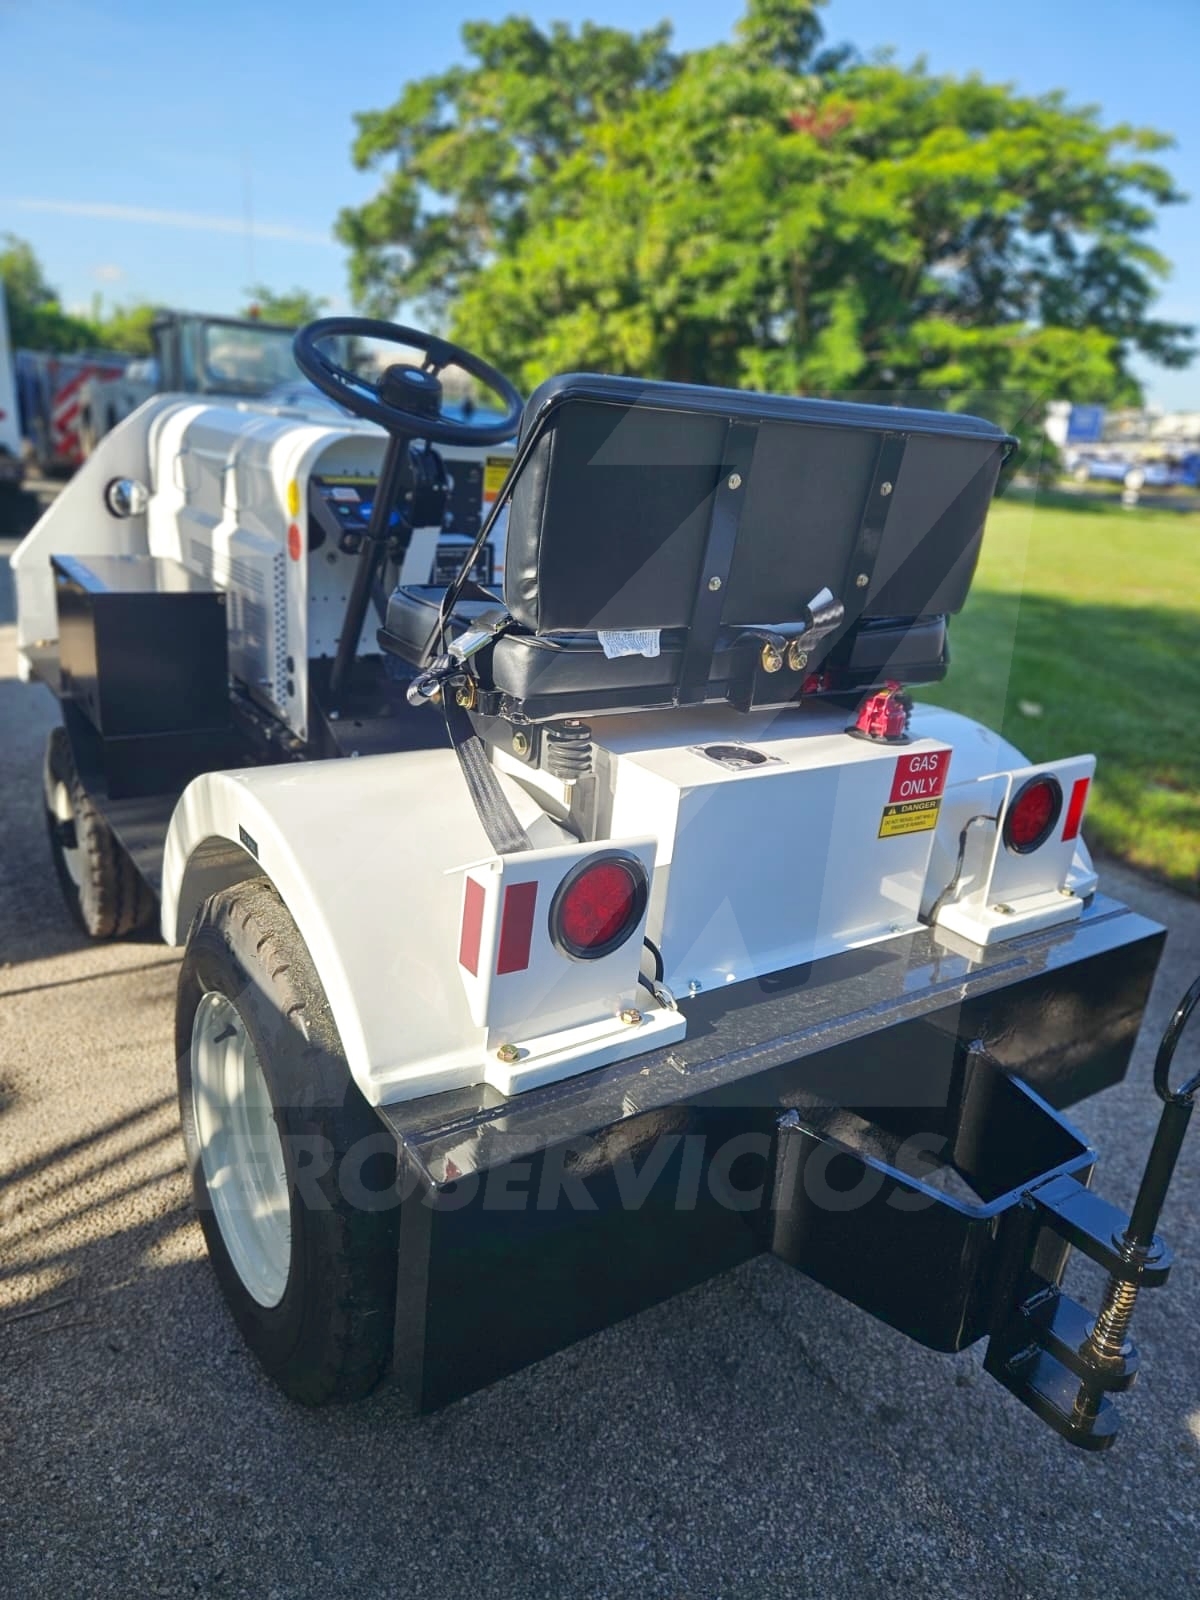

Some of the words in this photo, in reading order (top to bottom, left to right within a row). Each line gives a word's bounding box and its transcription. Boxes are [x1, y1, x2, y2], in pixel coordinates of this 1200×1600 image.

[910, 754, 938, 772] GAS
[900, 777, 938, 796] ONLY
[902, 801, 936, 812] DANGER
